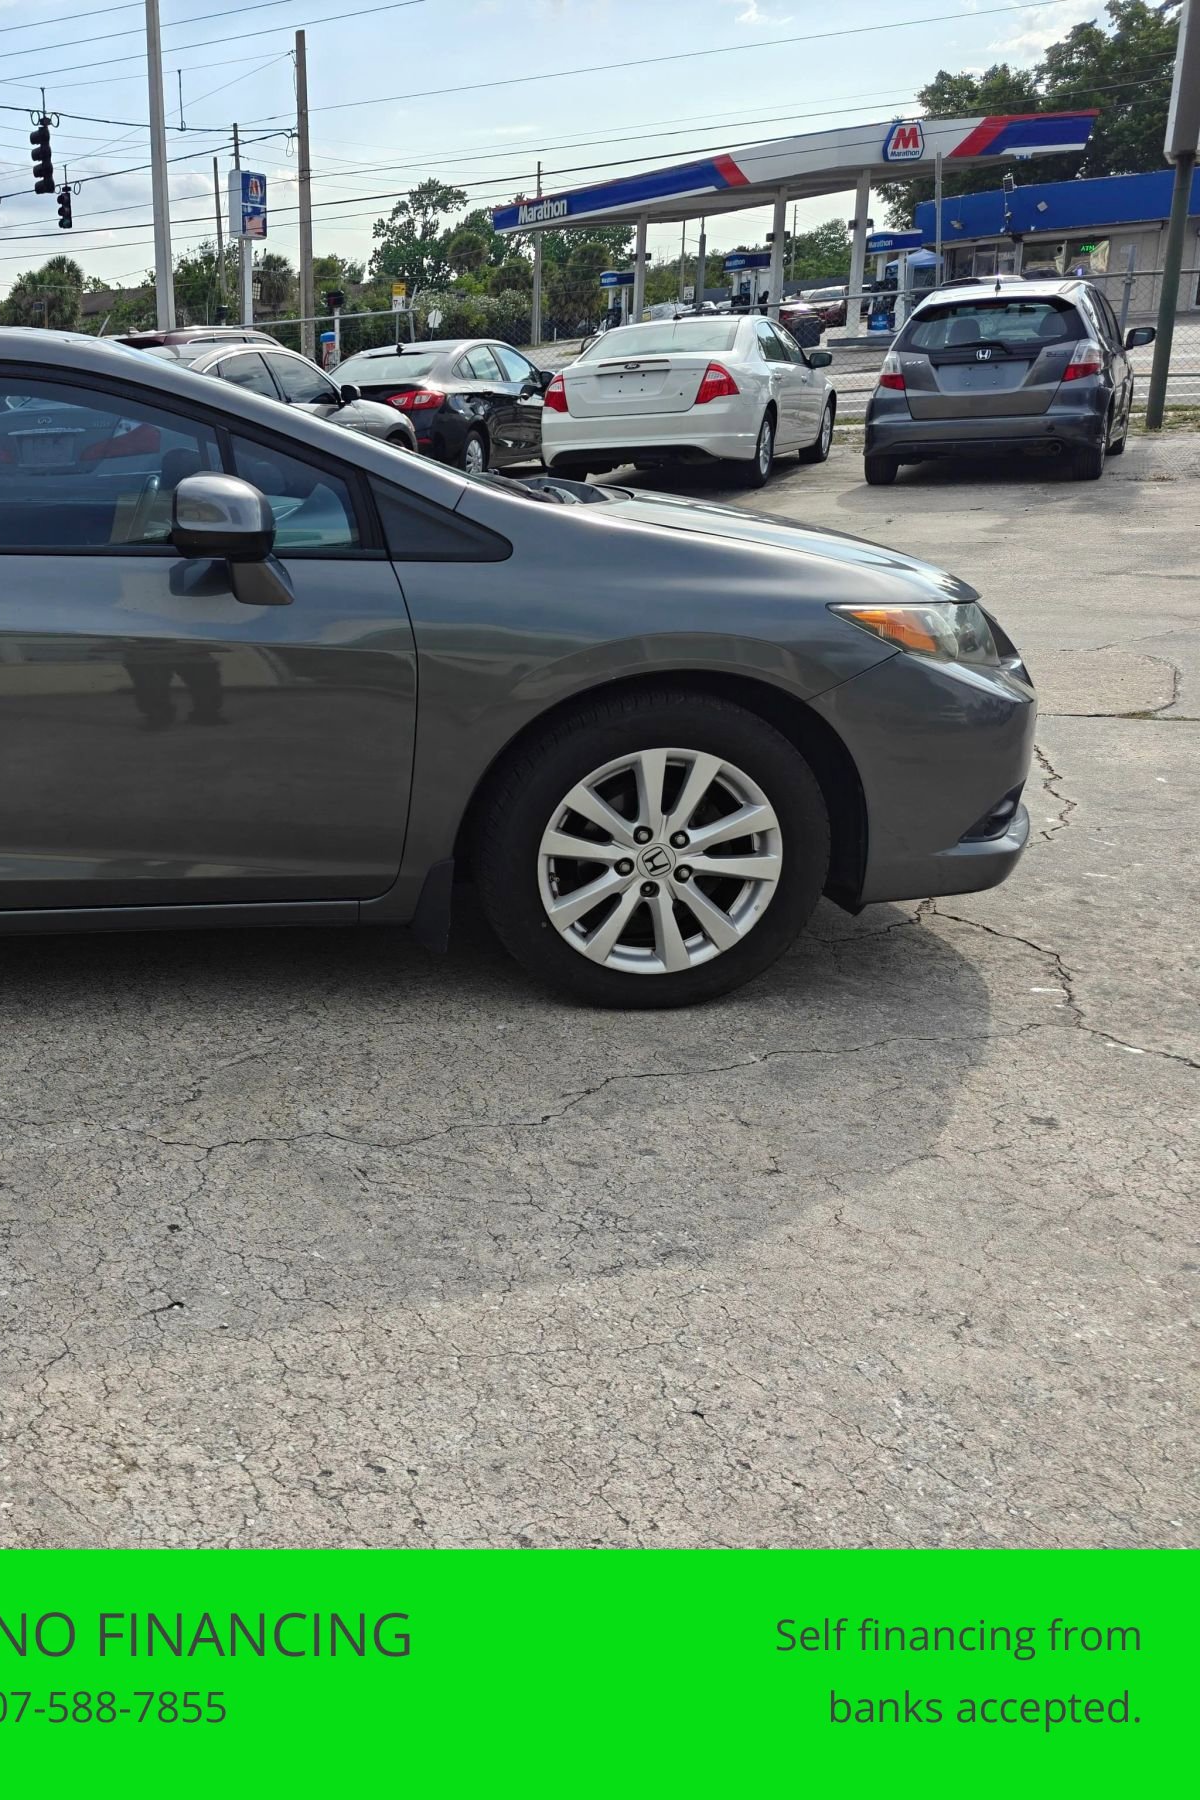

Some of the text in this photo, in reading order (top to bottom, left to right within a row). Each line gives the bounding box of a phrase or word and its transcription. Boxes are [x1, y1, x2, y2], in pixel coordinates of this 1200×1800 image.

[892, 127, 919, 149] M
[518, 199, 568, 225] Marathon
[1080, 243, 1095, 252] ATM
